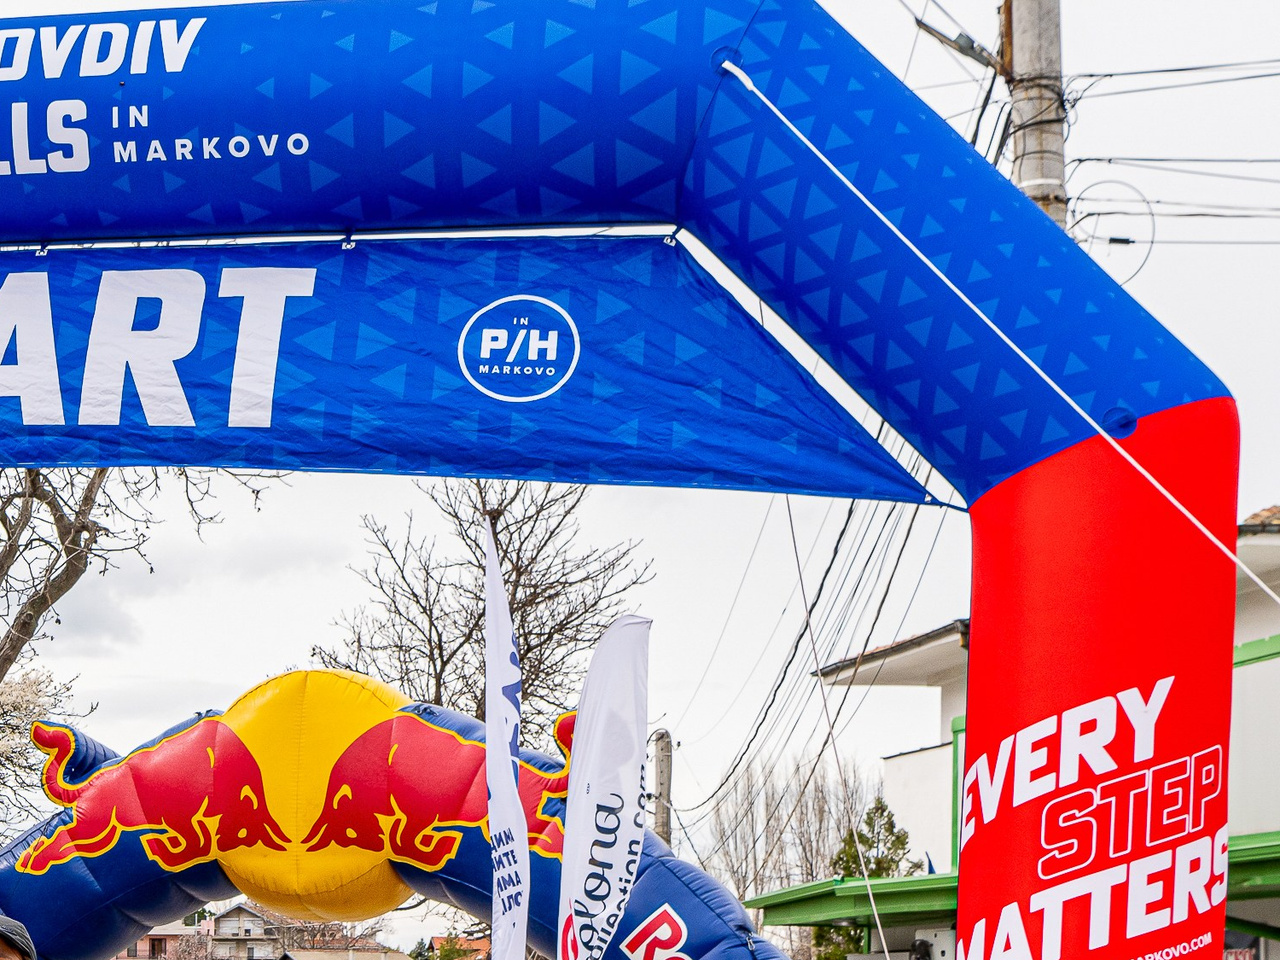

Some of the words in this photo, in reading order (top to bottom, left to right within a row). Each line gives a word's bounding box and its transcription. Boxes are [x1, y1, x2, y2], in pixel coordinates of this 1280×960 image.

[112, 105, 149, 128] IN
[113, 132, 310, 163] MARKOVO
[513, 317, 529, 326] IN
[480, 328, 558, 362] P/H
[479, 364, 556, 376] MARKOVO
[960, 675, 1176, 853] EVERY
[1037, 744, 1223, 880] STEP
